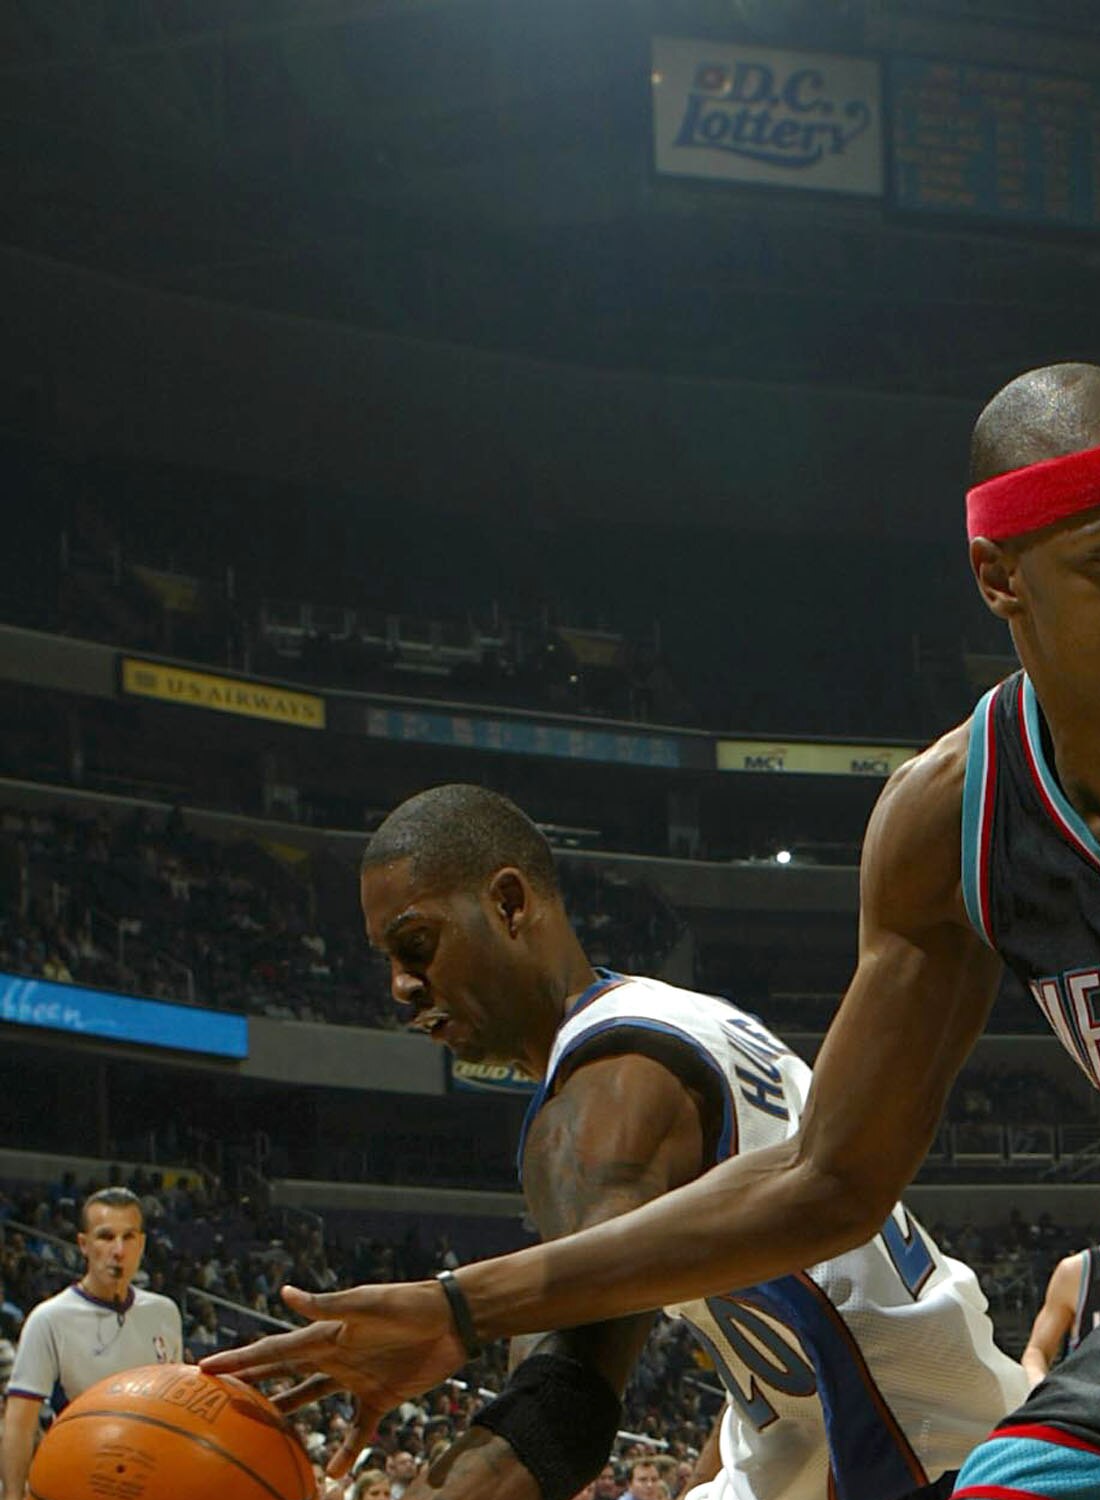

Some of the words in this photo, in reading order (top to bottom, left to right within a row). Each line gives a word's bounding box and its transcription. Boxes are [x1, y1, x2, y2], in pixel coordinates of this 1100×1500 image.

[728, 61, 834, 113] D.C.
[673, 95, 871, 167] Lottery
[208, 685, 315, 720] AIRWAYS
[744, 756, 784, 769] MCI
[851, 759, 889, 772] MCI
